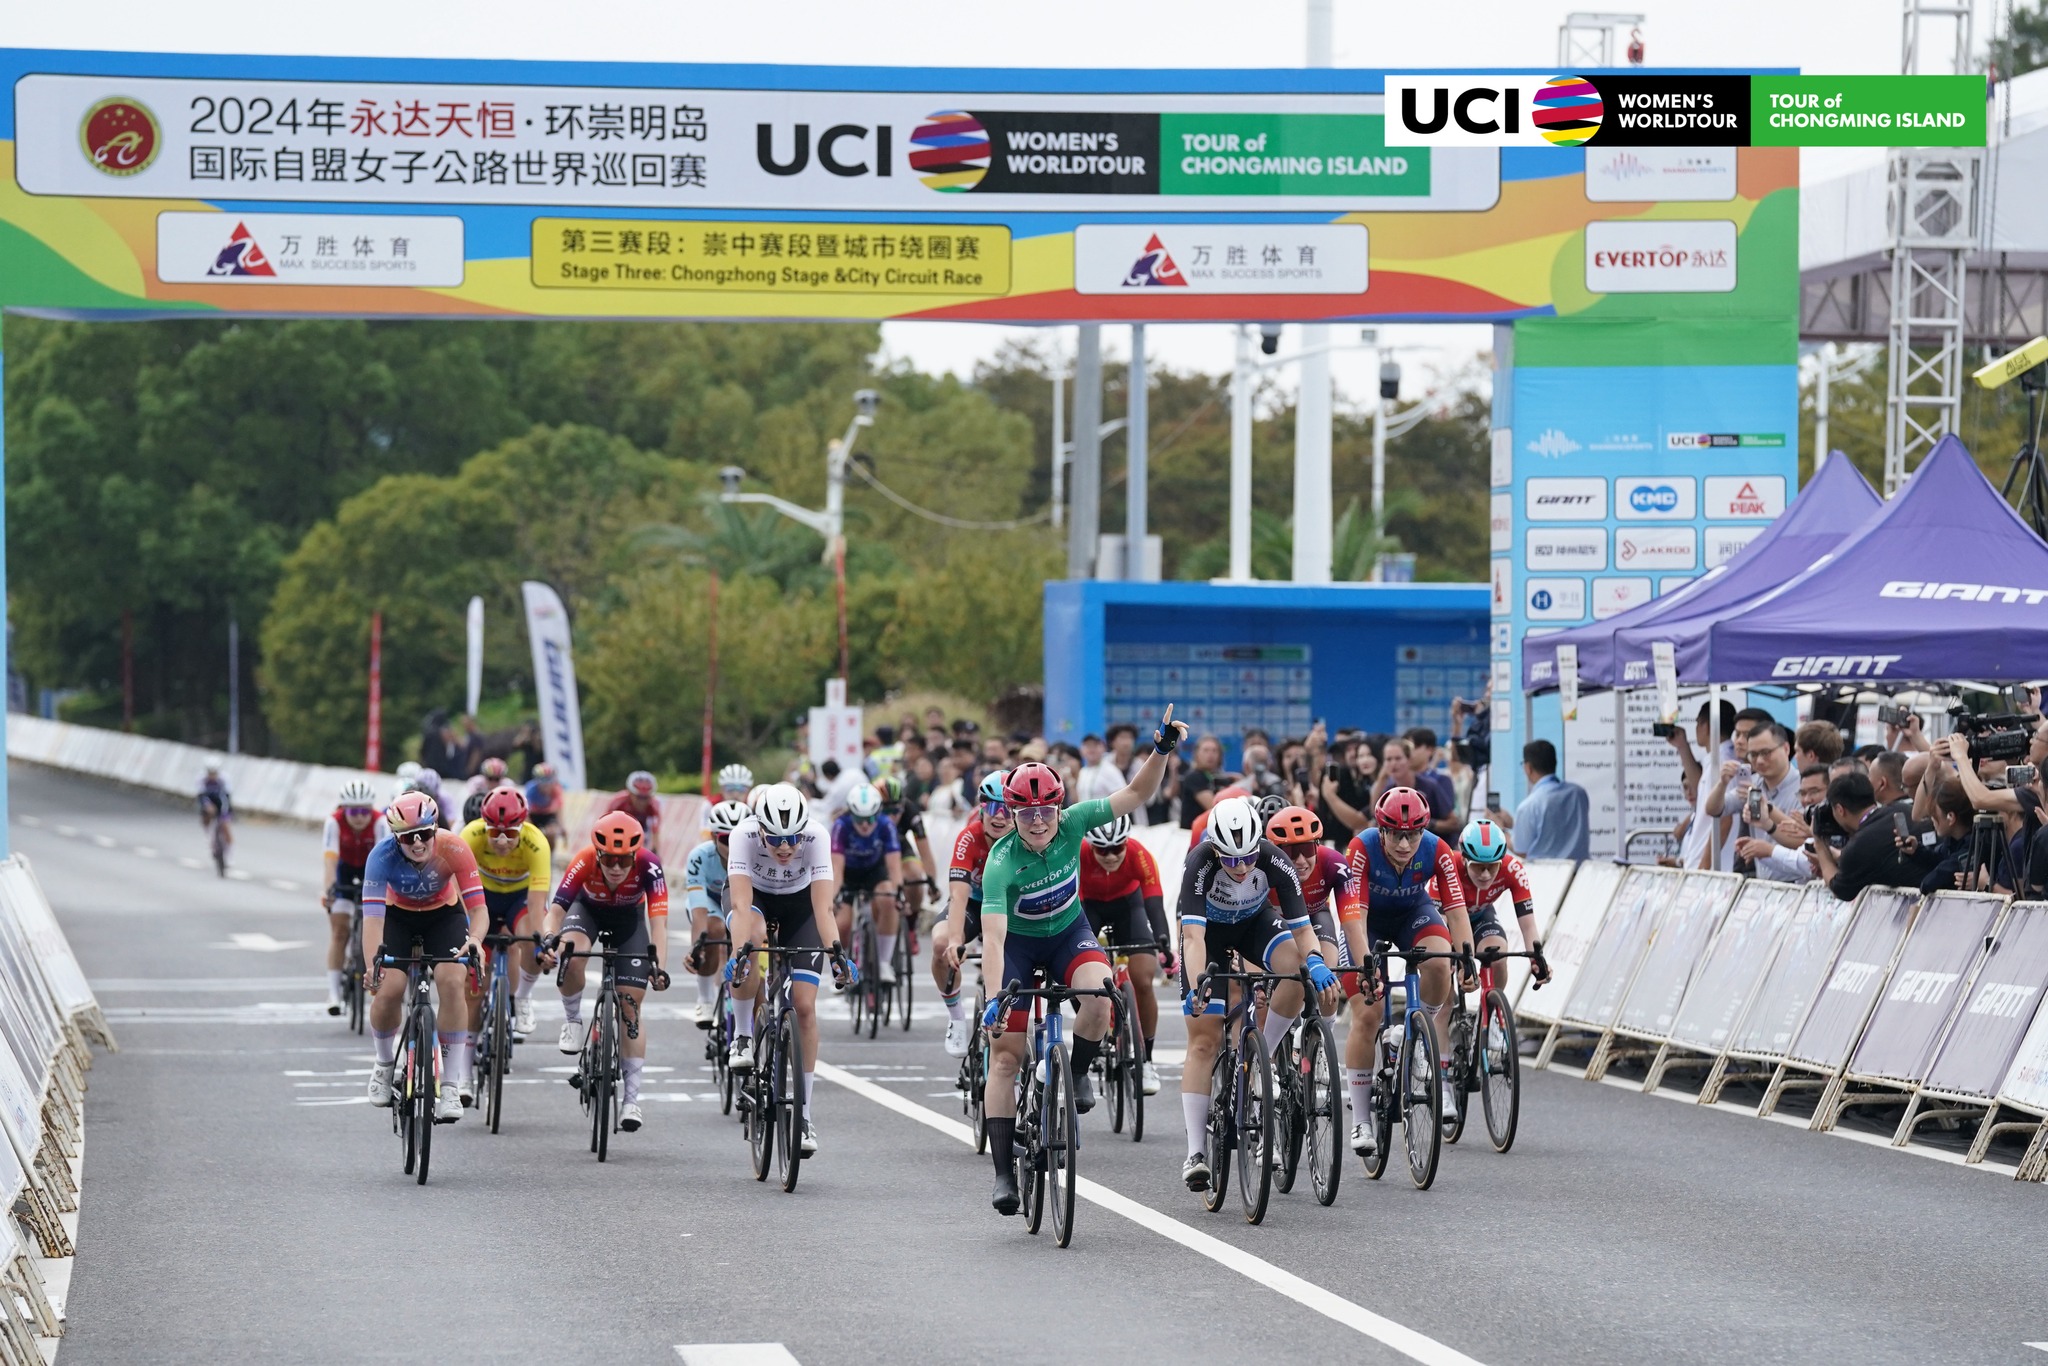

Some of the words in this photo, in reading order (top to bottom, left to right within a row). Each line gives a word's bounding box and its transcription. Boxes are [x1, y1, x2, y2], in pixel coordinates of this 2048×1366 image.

[757, 123, 892, 177] UCI
[1006, 131, 1119, 152] WOMEN'S
[1181, 133, 1241, 152] TOUR
[1244, 133, 1268, 152] of
[190, 146, 707, 188] 国际自盟女子公路世界巡回赛
[1006, 155, 1146, 175] WORLDTOUR
[1181, 156, 1324, 176] CHONGMING
[1326, 157, 1409, 176] ISLAND
[280, 234, 410, 258] 万胜体育
[1191, 244, 1317, 266] 万胜体育
[1595, 247, 1688, 268] EVERTOP
[280, 259, 304, 269] MAX
[310, 260, 367, 271] SUCCESS
[369, 260, 417, 271] SPORTS
[561, 261, 610, 283] Stage
[614, 263, 666, 281] Three:
[671, 264, 777, 286] Chongzhong
[781, 266, 830, 287] Stage
[884, 267, 938, 286] Circuit
[943, 269, 983, 286] Race
[1190, 269, 1215, 278] MAX
[1220, 269, 1275, 280] SUCCESS
[1277, 269, 1323, 280] SPORTS
[1671, 437, 1695, 446] UCI
[1536, 494, 1597, 506] GIANT
[1729, 502, 1766, 514] PEAK
[1879, 580, 2048, 604] GIANT
[1771, 654, 1902, 678] GIANT
[562, 858, 586, 889] THORNE
[1019, 868, 1062, 892] EVERTOP
[1270, 854, 1302, 896] VolkerWessels
[1438, 853, 1465, 900] CERATIZIT
[401, 881, 440, 894] UAE
[1828, 960, 1880, 994] GIANT
[1889, 970, 1961, 1004] GIANT
[1969, 982, 2039, 1018] GIANT
